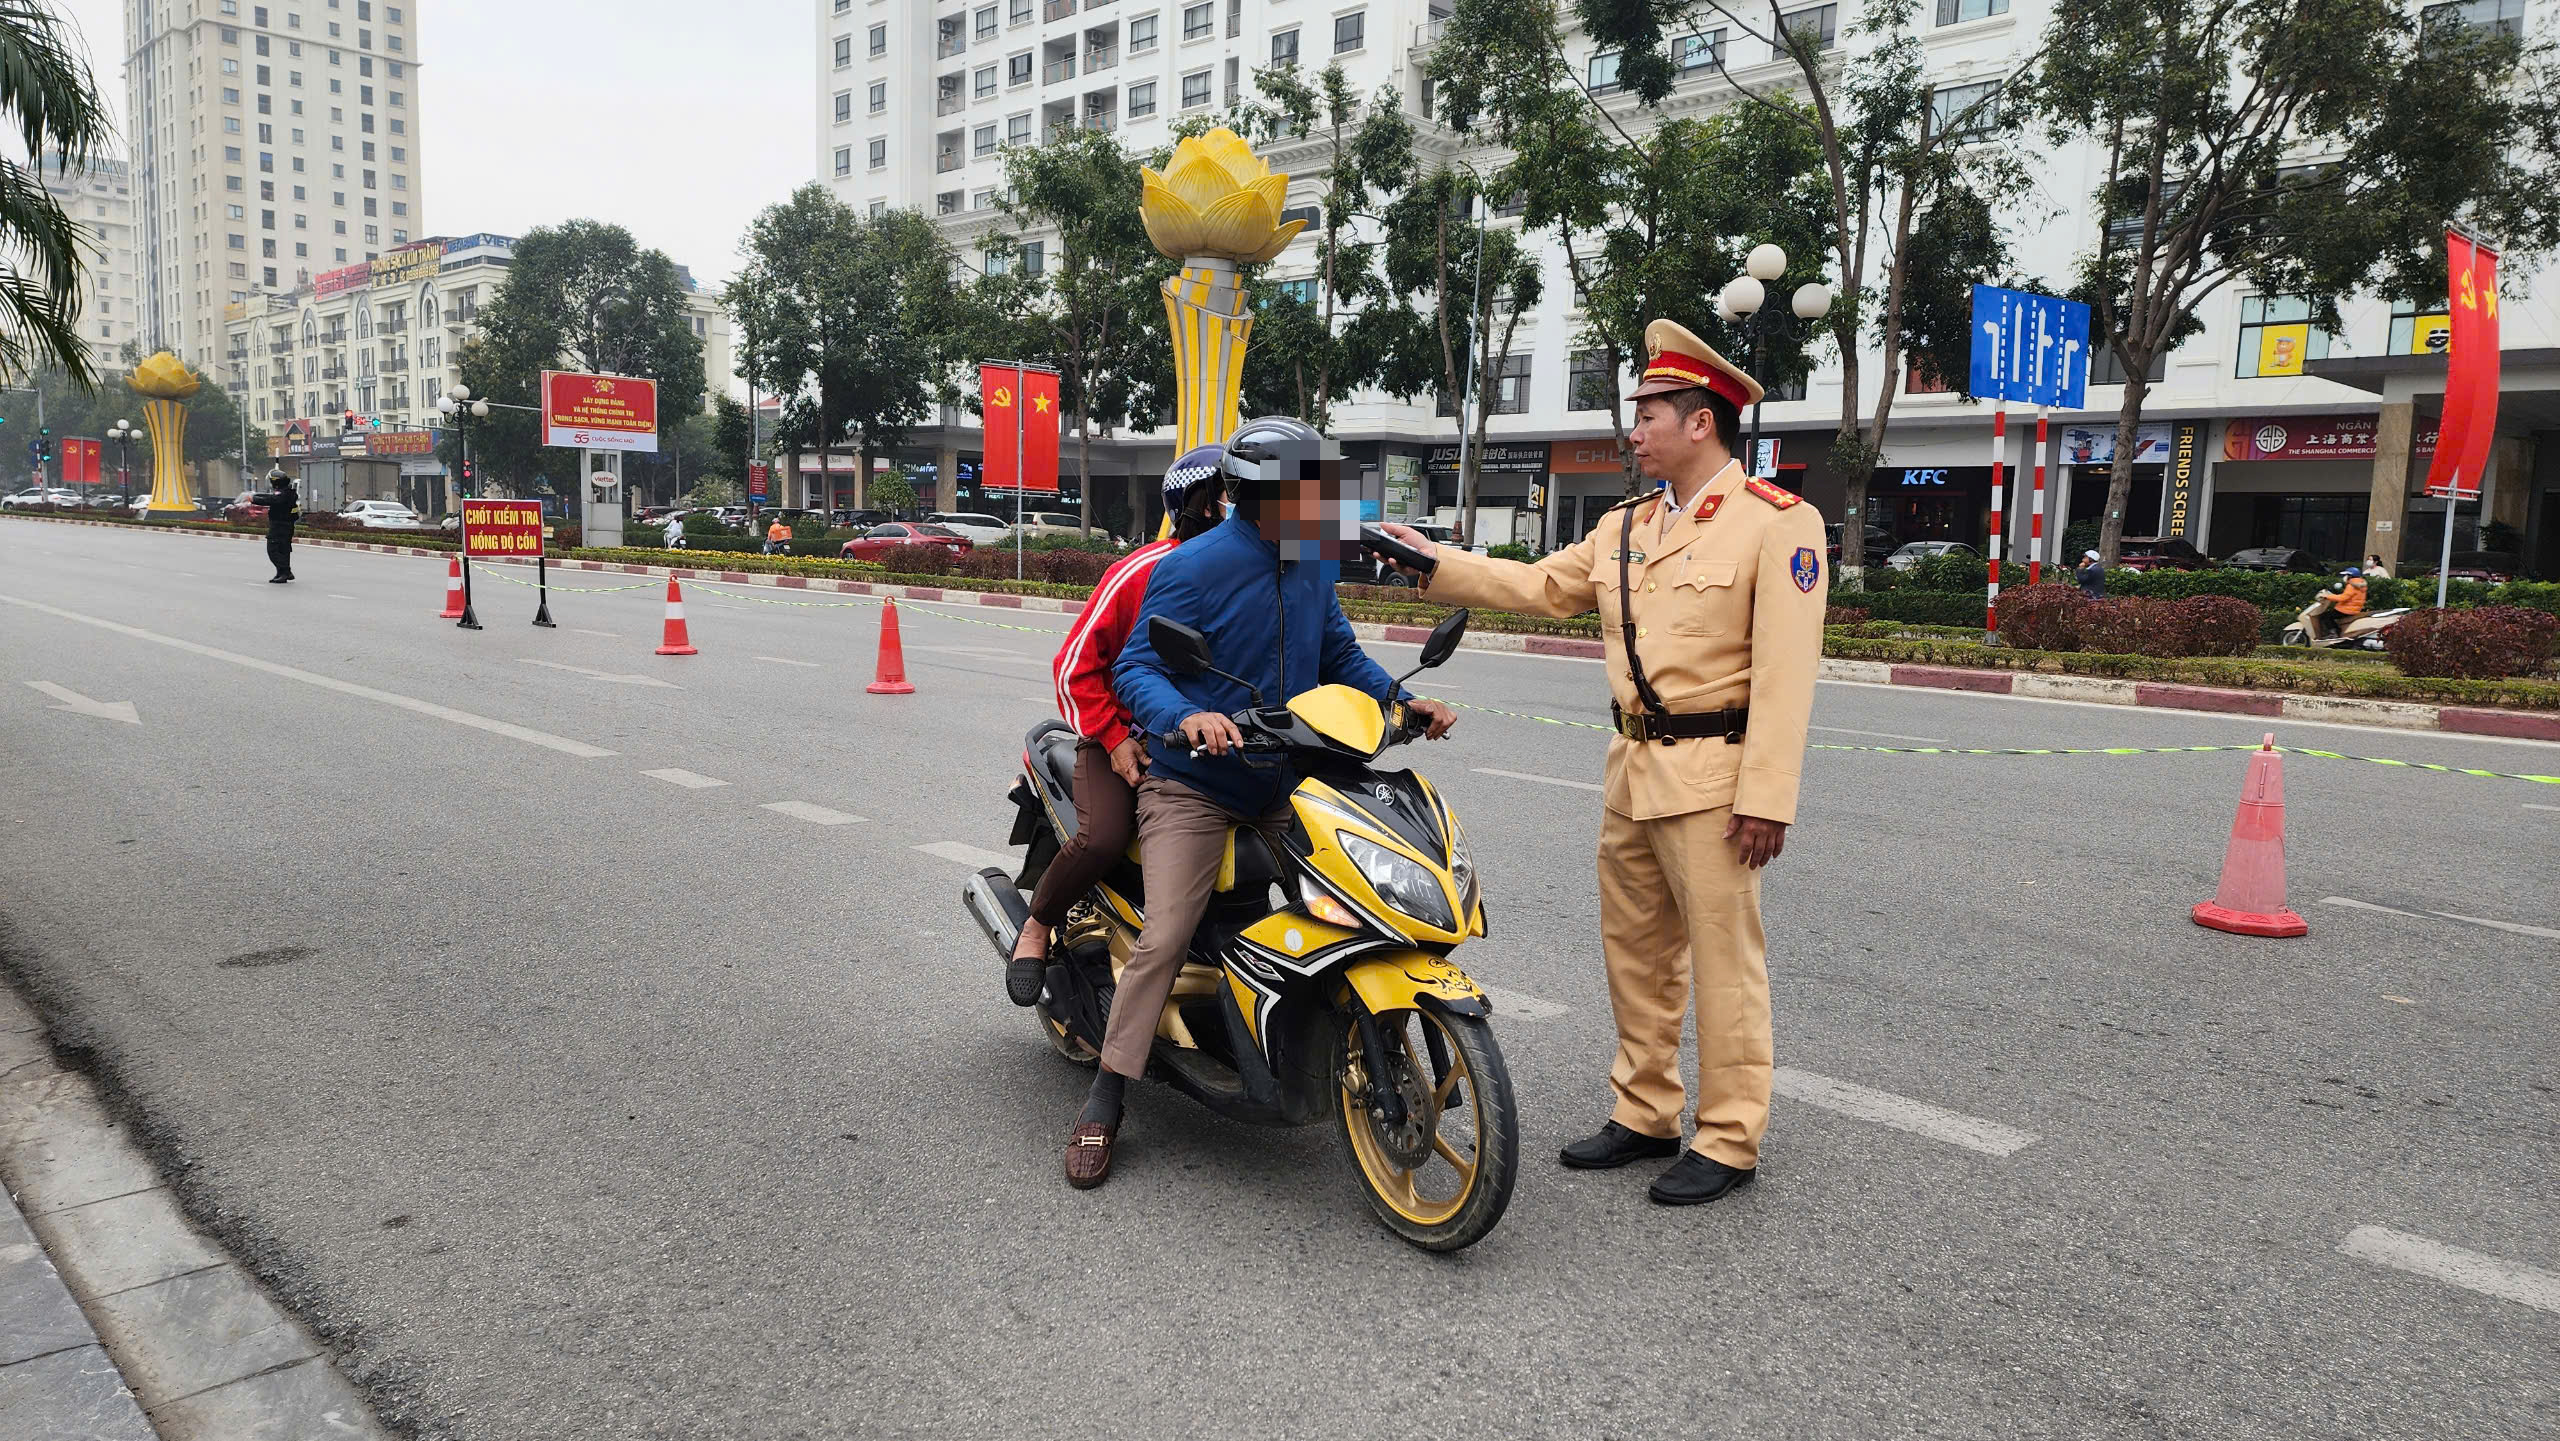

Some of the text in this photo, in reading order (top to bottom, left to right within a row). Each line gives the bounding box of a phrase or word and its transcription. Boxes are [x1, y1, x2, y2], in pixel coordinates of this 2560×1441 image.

[574, 433, 590, 444] 5G
[1901, 469, 1948, 485] KFC
[2170, 426, 2193, 537] FRIENDS SCREE
[465, 504, 539, 525] CHỐT KIỂM TRA
[500, 532, 515, 553] ĐỘ
[516, 530, 537, 550] CỒN
